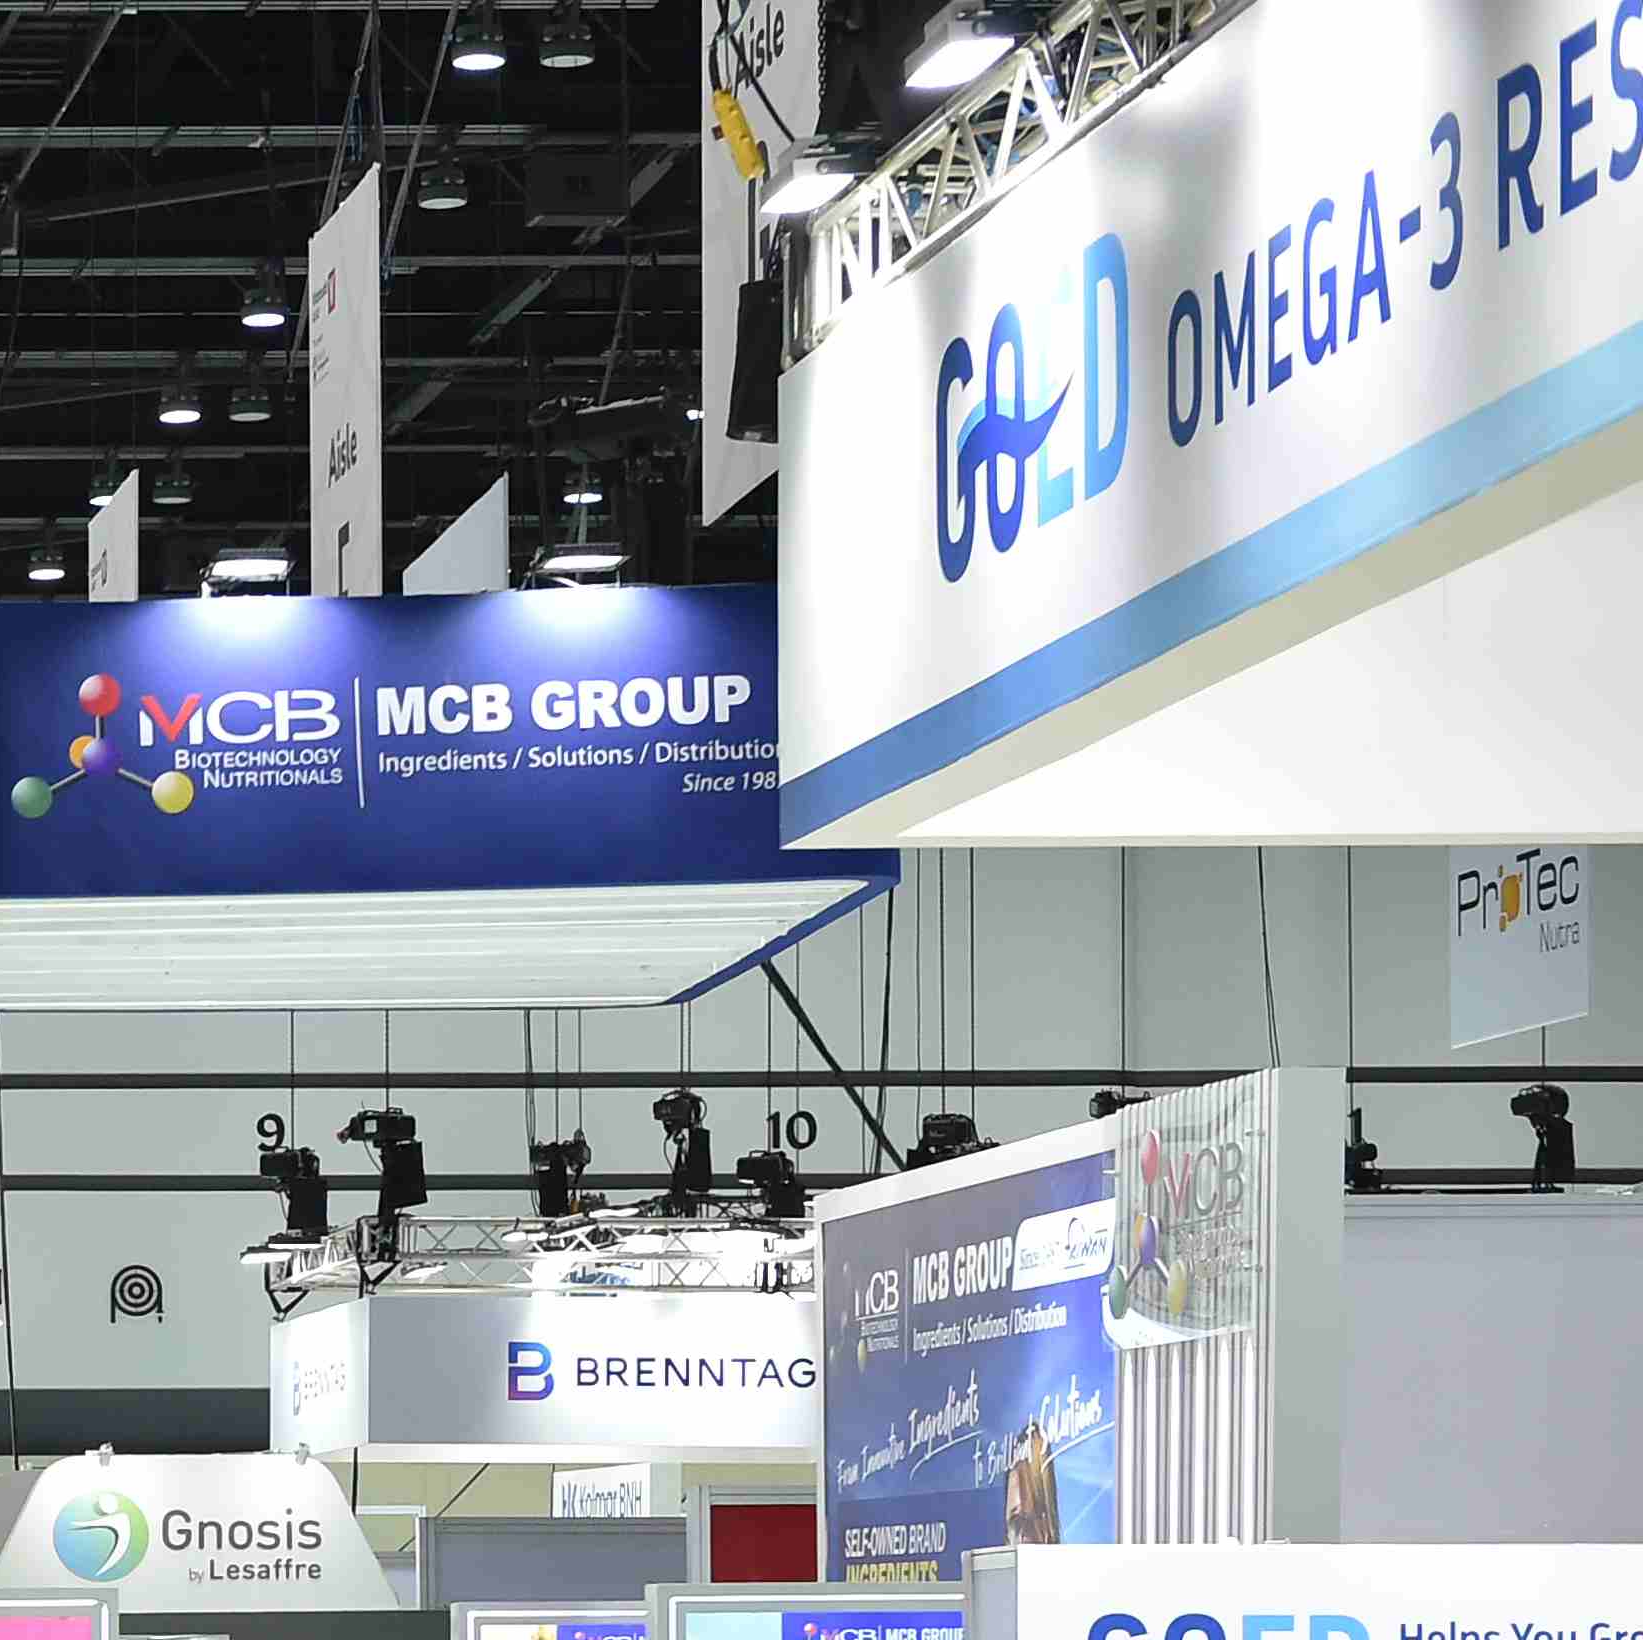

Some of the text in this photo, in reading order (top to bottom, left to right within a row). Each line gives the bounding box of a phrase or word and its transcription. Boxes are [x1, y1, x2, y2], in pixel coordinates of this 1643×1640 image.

[1167, 111, 1465, 448] OMEGA-3
[328, 421, 359, 489] Aisle
[139, 674, 751, 747] MCB MCB GROUP
[174, 747, 343, 770] BIOTECHNOLOGY
[203, 768, 344, 789] NUTRITIONALS
[378, 747, 508, 778] Ingredients
[527, 741, 634, 769] Solutions
[681, 772, 736, 794] Since
[1539, 921, 1580, 953] Nutra
[256, 1113, 285, 1152] 9
[767, 1110, 817, 1151] 10
[913, 1250, 949, 1305] MCB
[953, 1235, 1013, 1298] GROUP
[913, 1301, 1067, 1357] Ingredients Solutions Distribution
[575, 1356, 817, 1389] BRENNTAG
[908, 1368, 980, 1456] Ingredients
[1037, 1374, 1103, 1455] Solutions
[161, 1508, 323, 1552] Gnosis
[844, 1521, 947, 1558] SELF-OWNED BRAND
[188, 1558, 323, 1583] by Lesaffre
